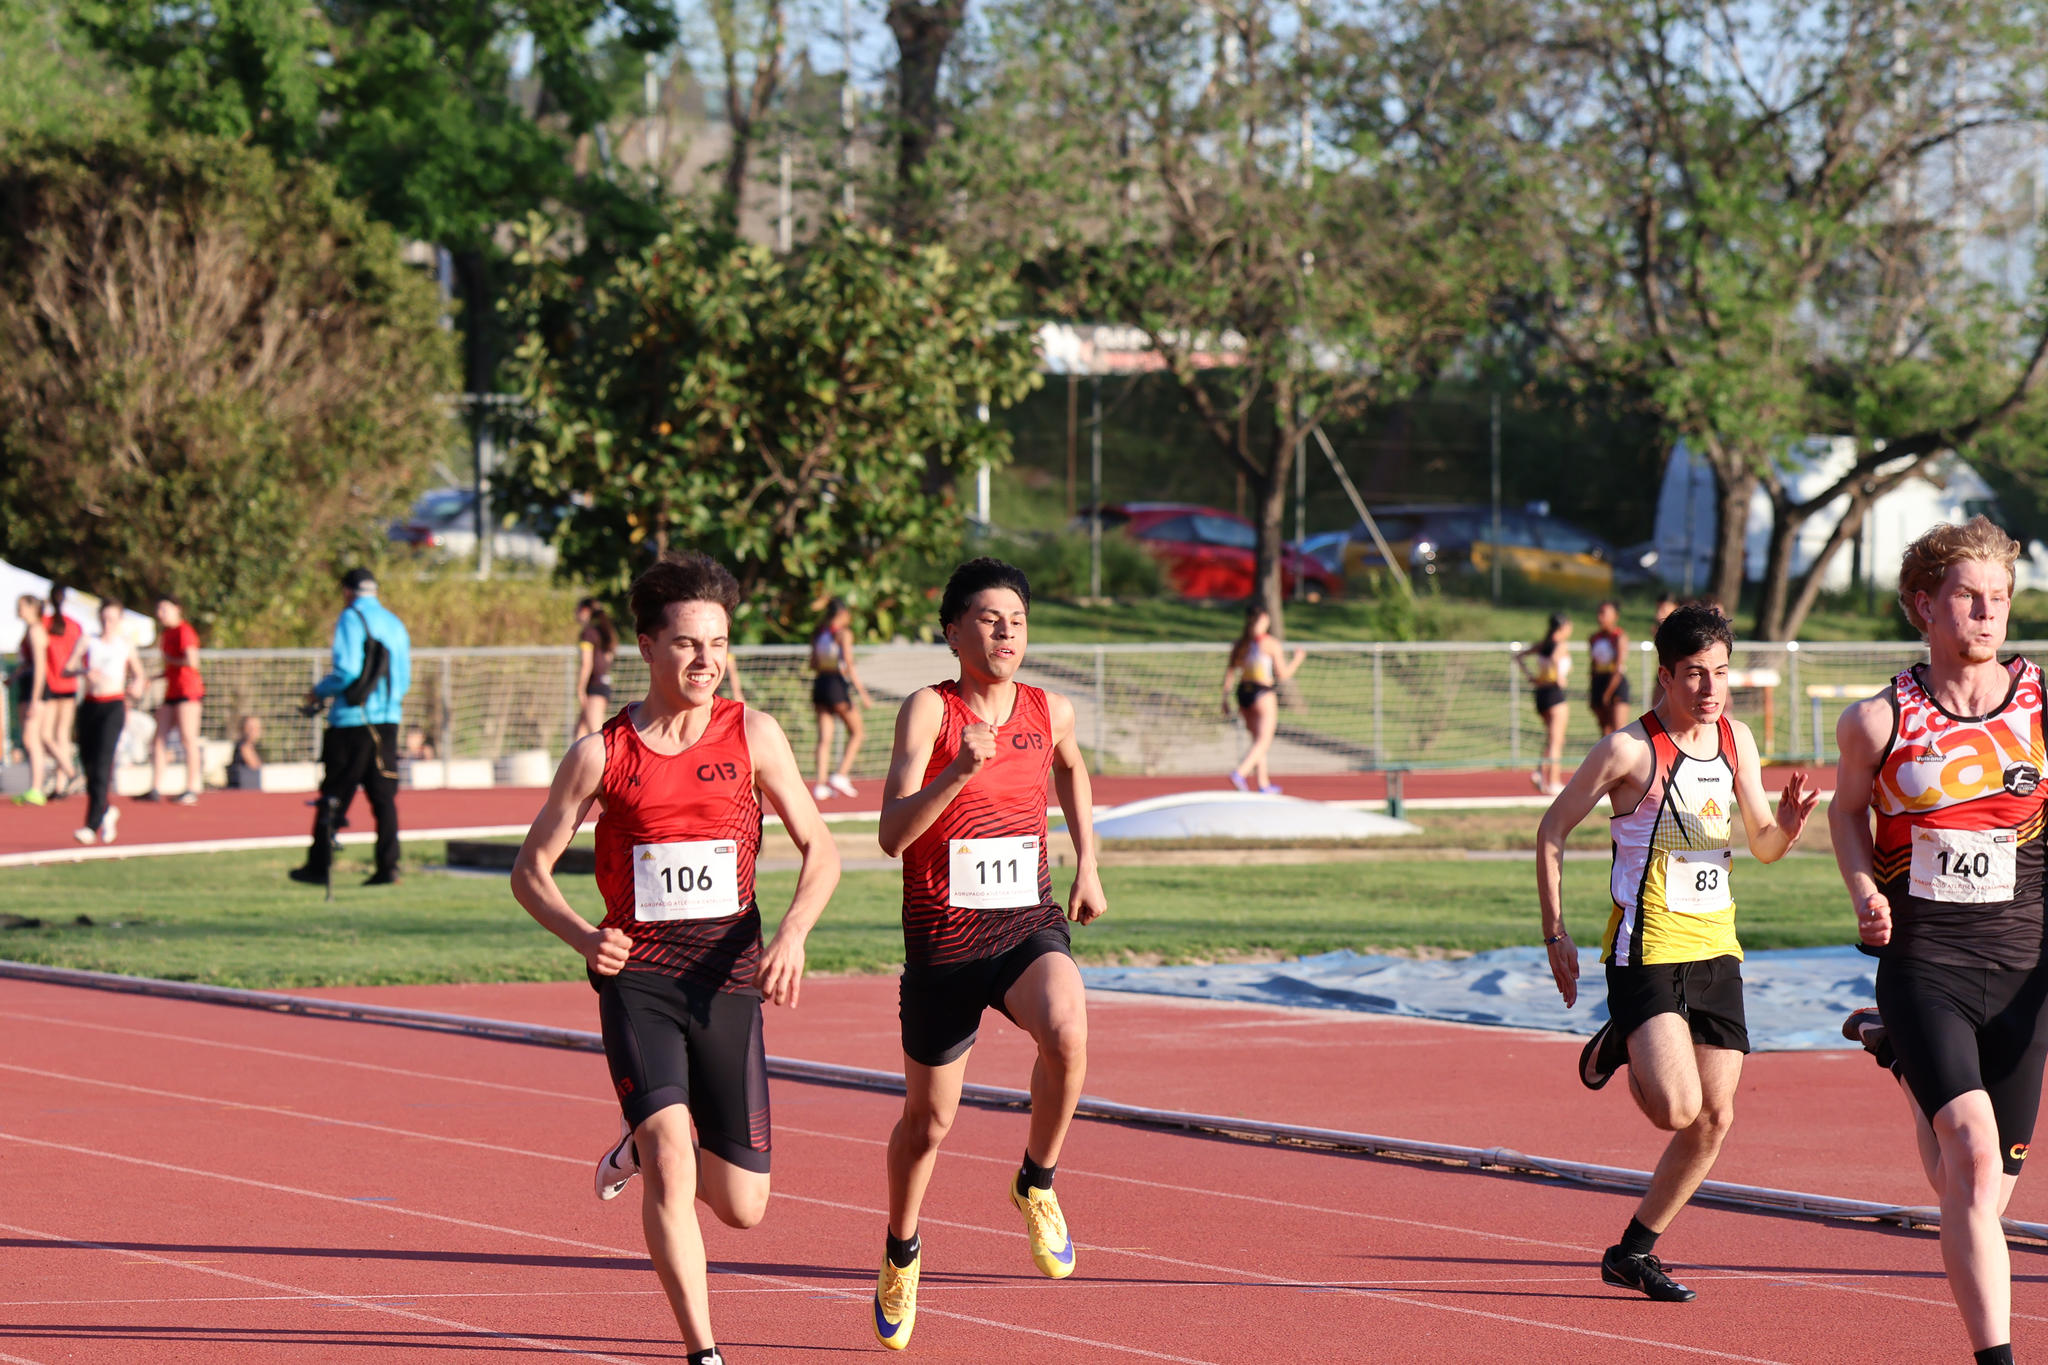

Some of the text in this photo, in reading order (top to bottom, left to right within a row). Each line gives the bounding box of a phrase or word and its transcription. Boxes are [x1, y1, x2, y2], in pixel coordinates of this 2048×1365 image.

[976, 858, 1018, 885] 111
[1937, 851, 1989, 878] 140
[661, 865, 713, 893] 106
[1695, 869, 1718, 892] 83
